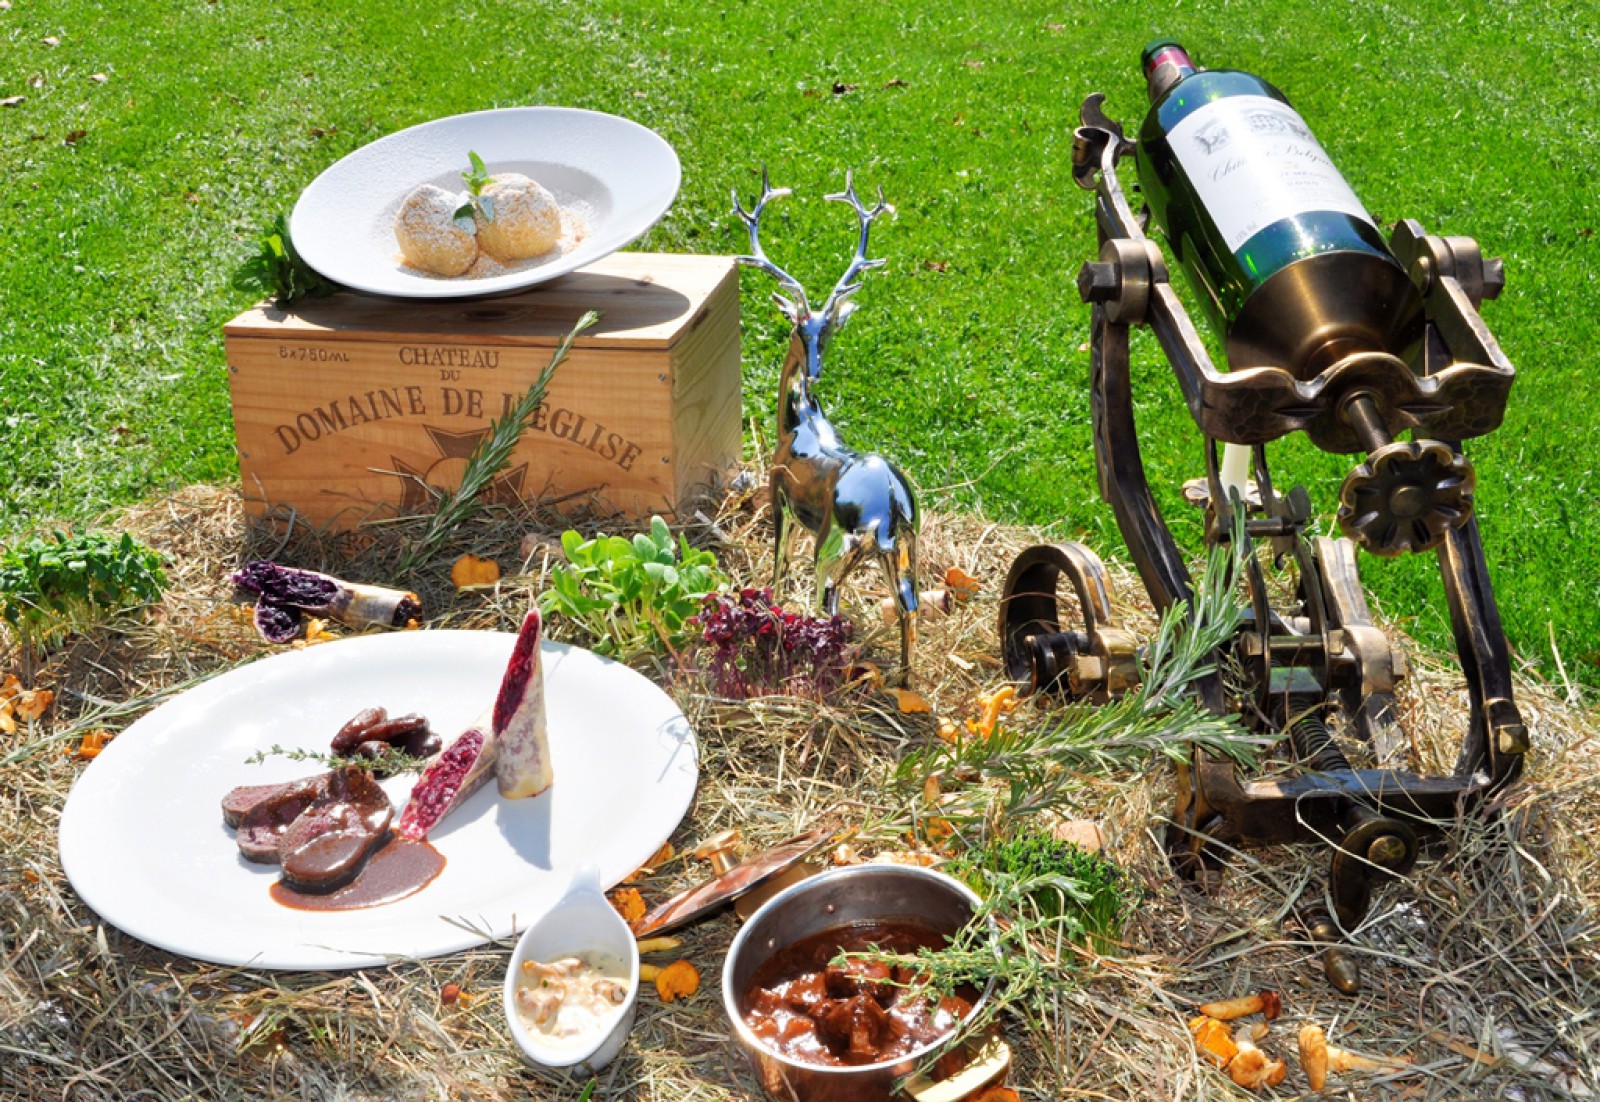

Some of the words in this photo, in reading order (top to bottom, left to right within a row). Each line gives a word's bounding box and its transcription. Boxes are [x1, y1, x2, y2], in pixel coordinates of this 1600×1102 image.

[399, 346, 499, 368] CHATEAU
[439, 369, 461, 382] DU
[274, 385, 426, 455] DOMAINE
[440, 387, 484, 419] DE
